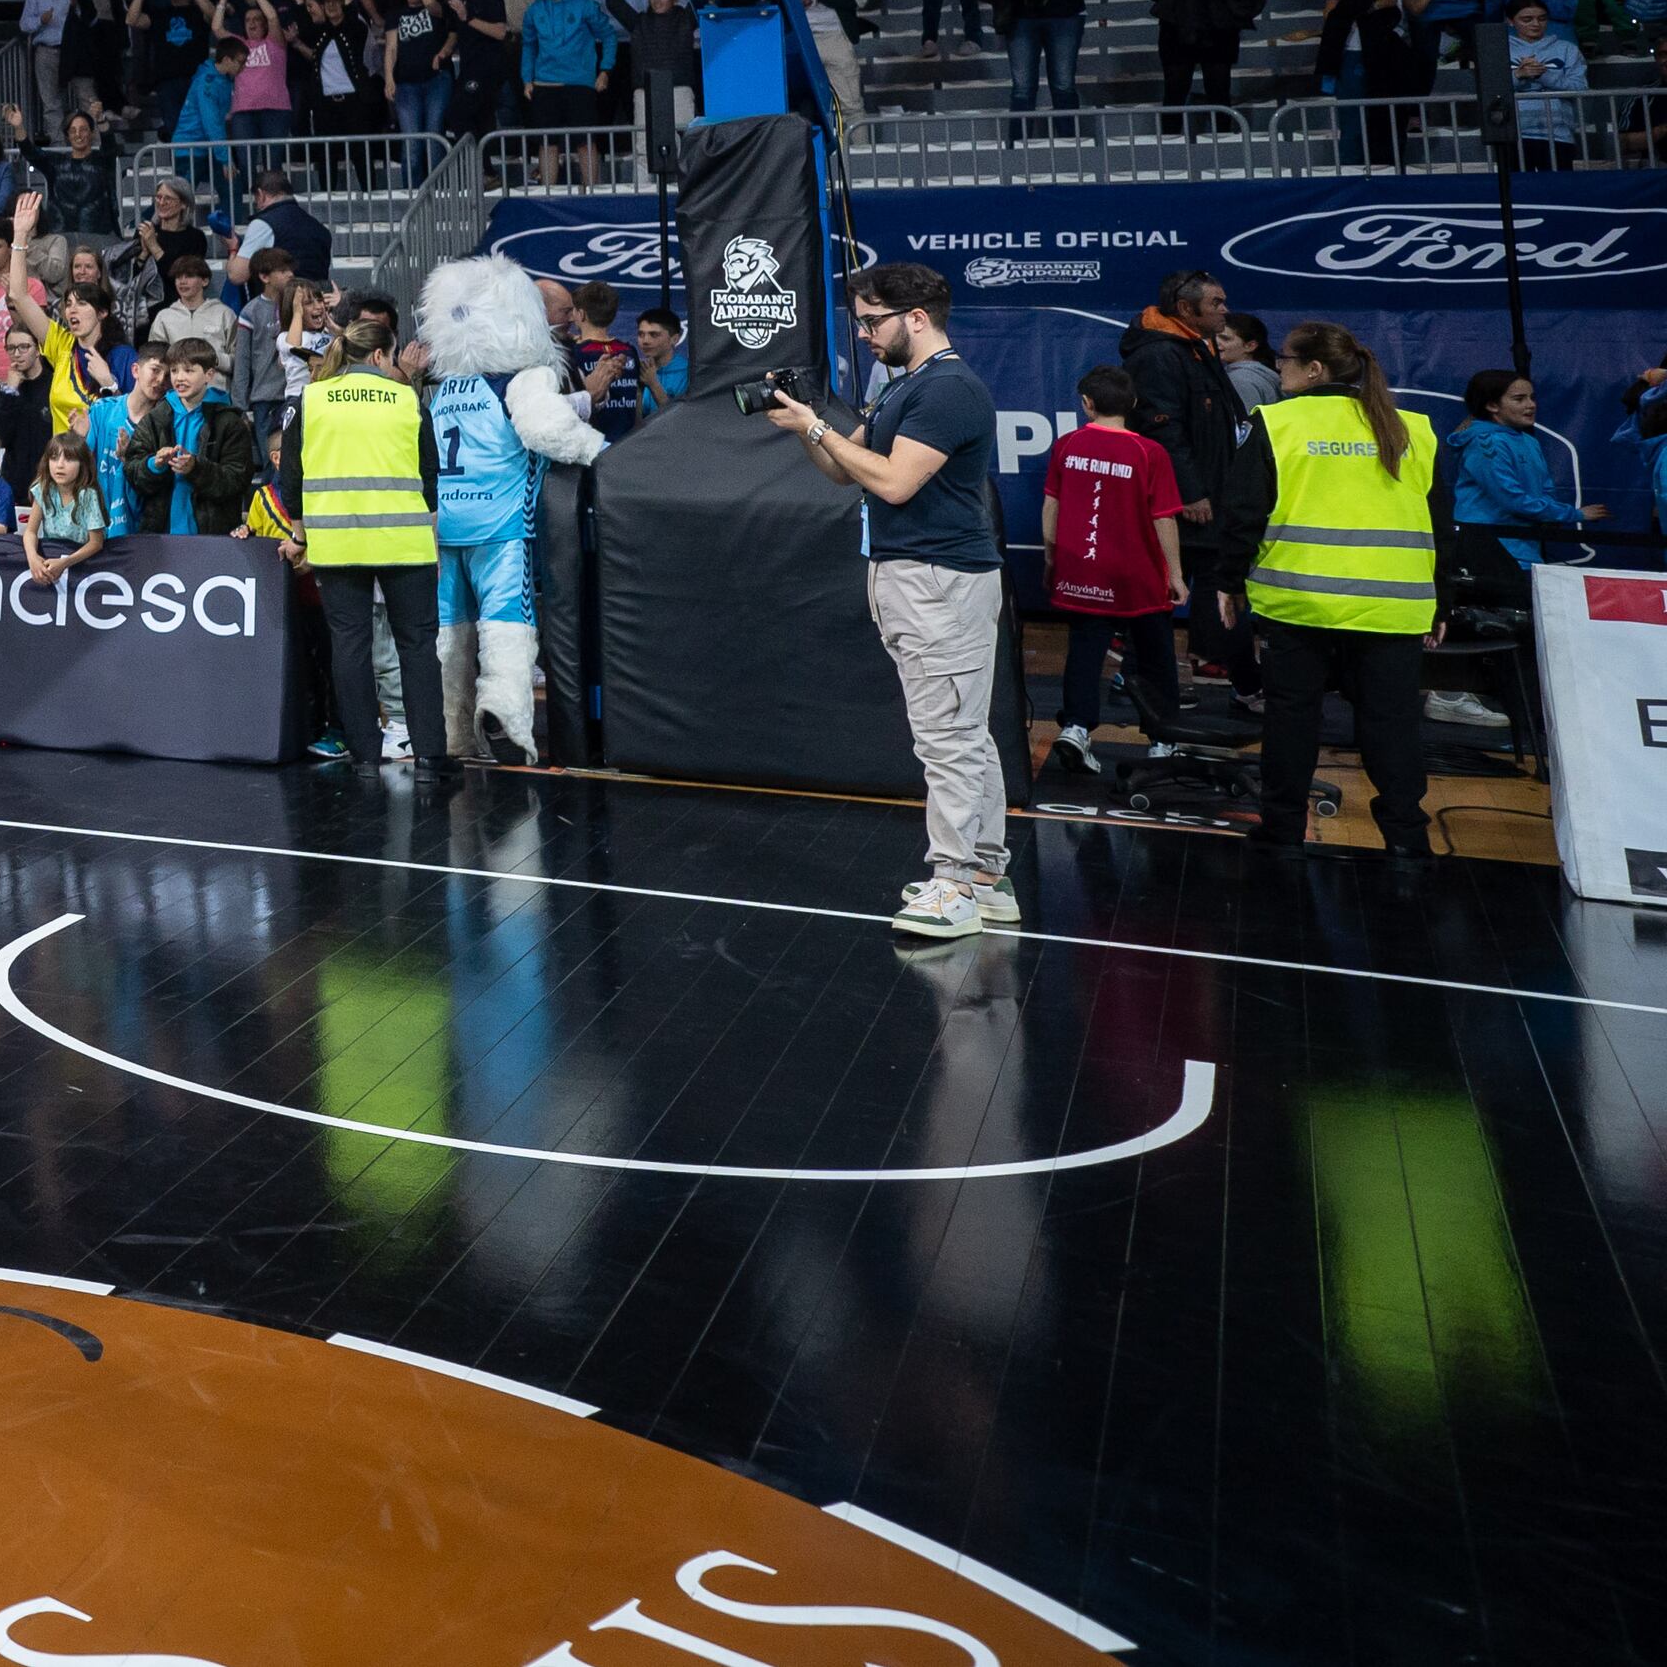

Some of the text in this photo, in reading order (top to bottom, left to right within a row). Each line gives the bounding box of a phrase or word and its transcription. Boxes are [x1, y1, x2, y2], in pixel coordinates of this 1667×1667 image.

[906, 228, 1189, 252] VEHICLE OFICIAL
[1313, 211, 1632, 273] Ford
[1007, 269, 1097, 280] ANDORRA
[1009, 262, 1096, 272] MORABANC
[714, 292, 793, 306] MORABANC
[714, 303, 795, 323] ANDORRA
[326, 388, 398, 405] SEGURETAT
[438, 424, 466, 477] 1
[1064, 454, 1089, 472] #WE
[1089, 458, 1111, 476] RUN
[441, 490, 494, 502] ndorra
